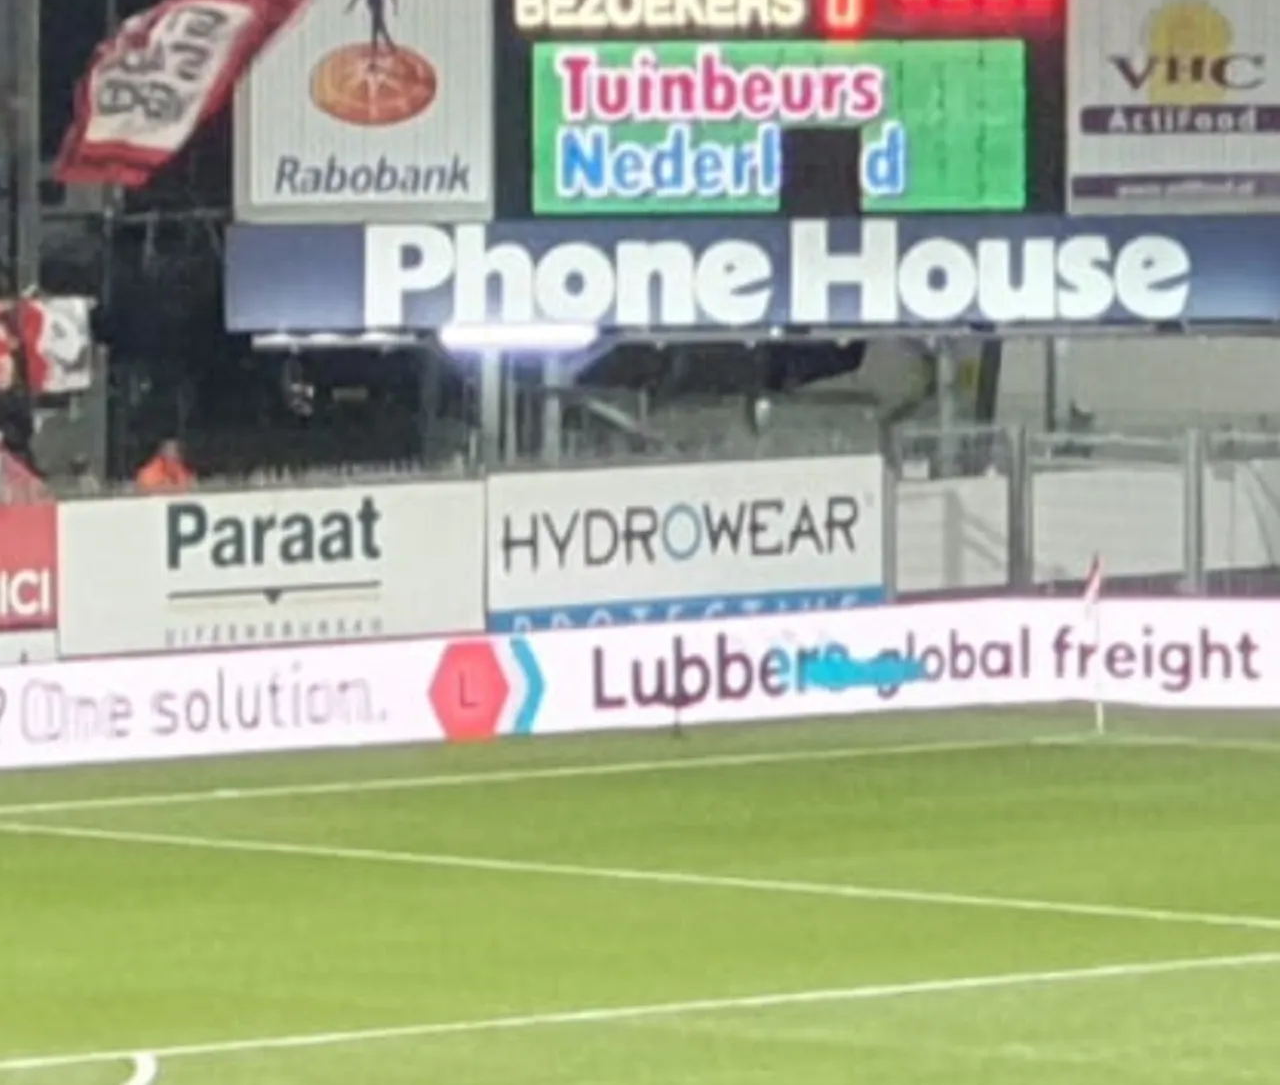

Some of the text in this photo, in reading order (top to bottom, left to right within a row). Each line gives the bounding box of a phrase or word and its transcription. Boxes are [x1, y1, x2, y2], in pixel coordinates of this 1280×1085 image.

[561, 49, 881, 114] Tuinbeurs
[1106, 52, 1267, 92] VHC
[274, 151, 470, 196] Rabobank
[558, 123, 904, 192] Nederld
[362, 218, 1190, 329] Phone House
[166, 495, 383, 571] Paraat
[500, 495, 860, 573] HYDROWEAR
[1053, 627, 1261, 693] freight
[150, 662, 389, 736] solution.
